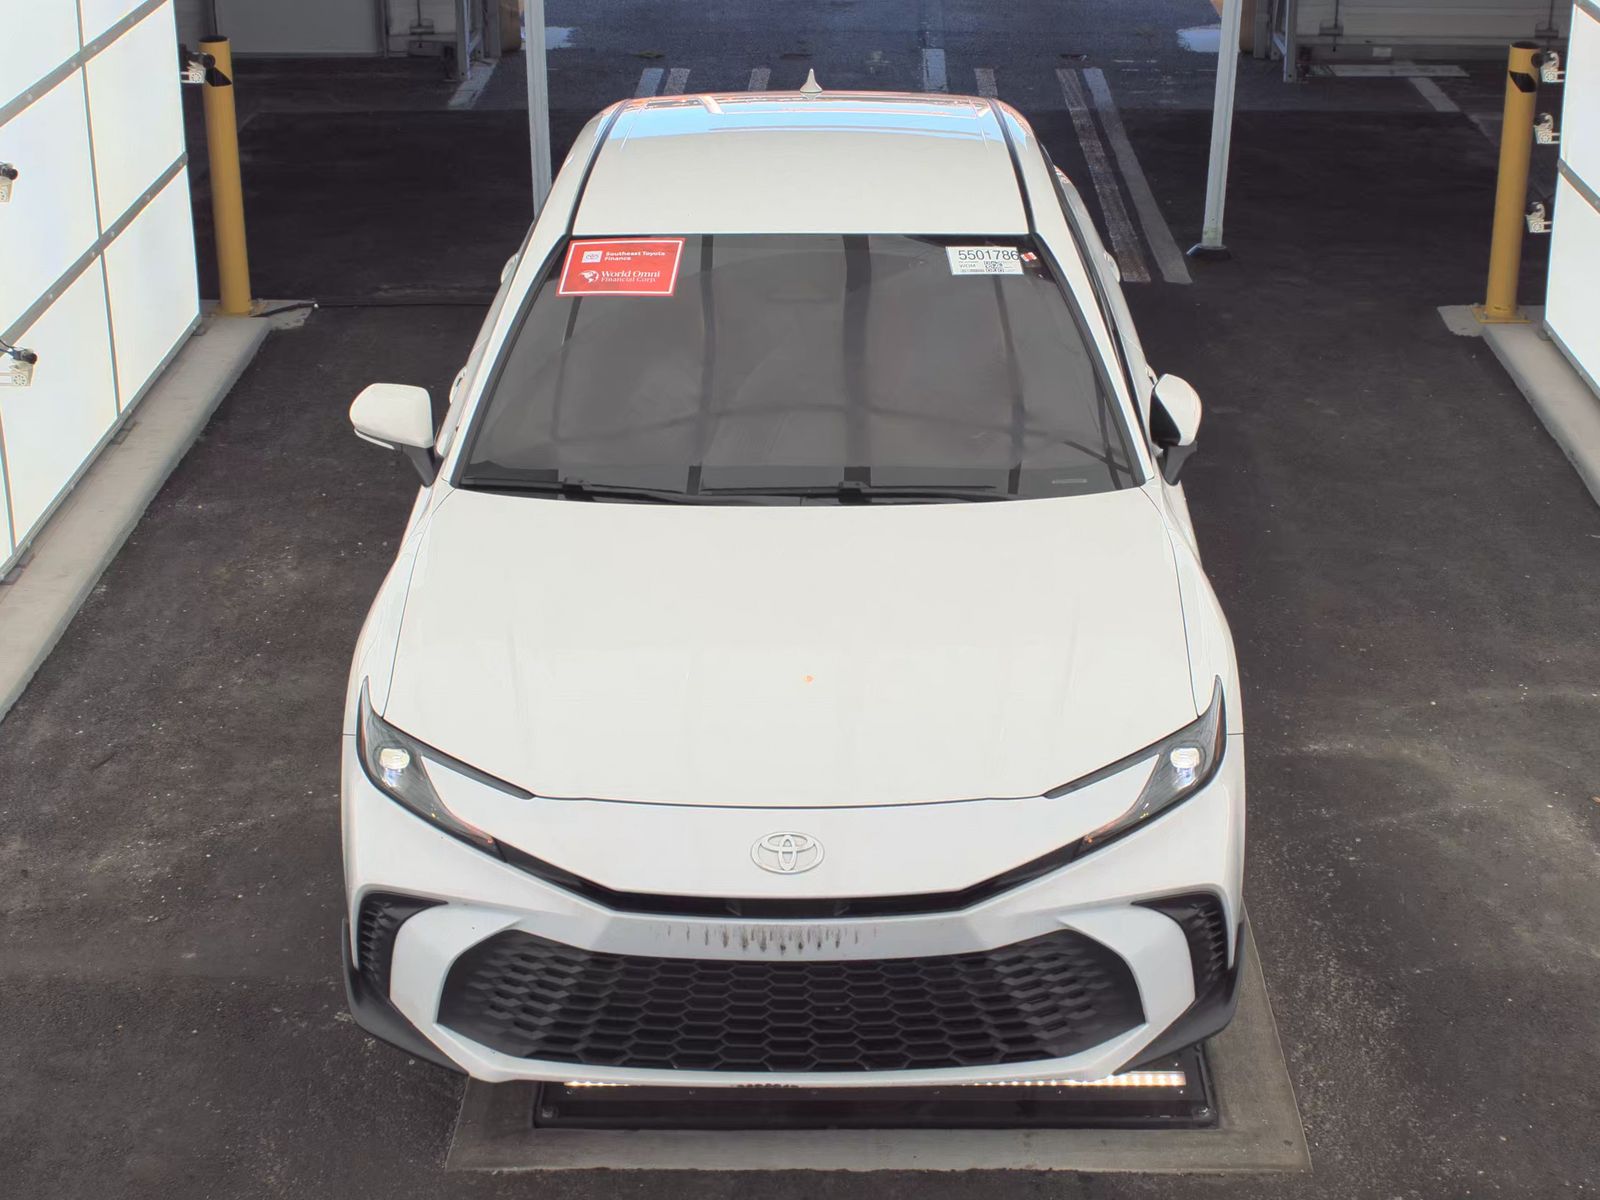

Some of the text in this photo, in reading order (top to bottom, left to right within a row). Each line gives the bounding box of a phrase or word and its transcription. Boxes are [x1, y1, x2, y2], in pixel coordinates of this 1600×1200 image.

[958, 249, 1019, 261] 5501786
[601, 270, 660, 278] World Omni
